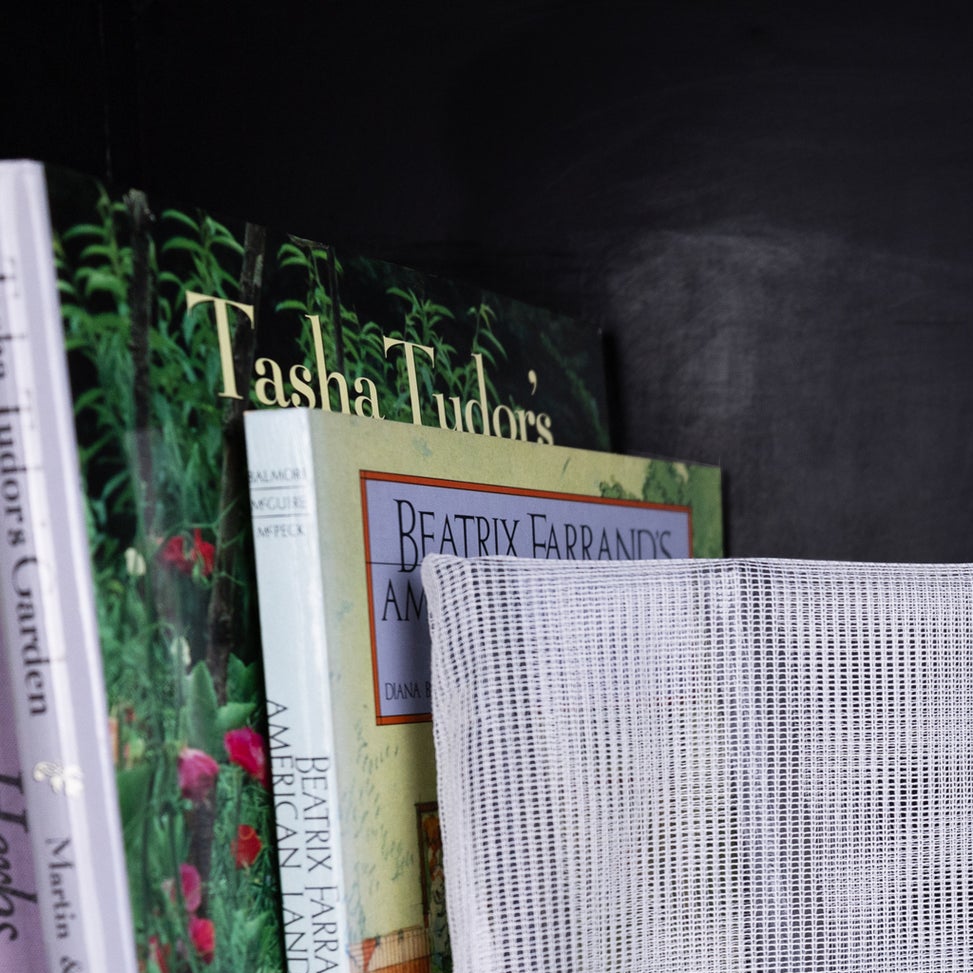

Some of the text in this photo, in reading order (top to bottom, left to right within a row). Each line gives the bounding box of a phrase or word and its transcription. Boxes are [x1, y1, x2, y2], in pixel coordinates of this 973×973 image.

[186, 290, 554, 447] Tasha Tudor's
[394, 498, 672, 573] BEATRIX FARRAND'S
[385, 682, 421, 701] DIANA
[267, 700, 302, 868] AMERICAN
[295, 757, 333, 872] BEATRIX
[46, 837, 76, 940] Martin
